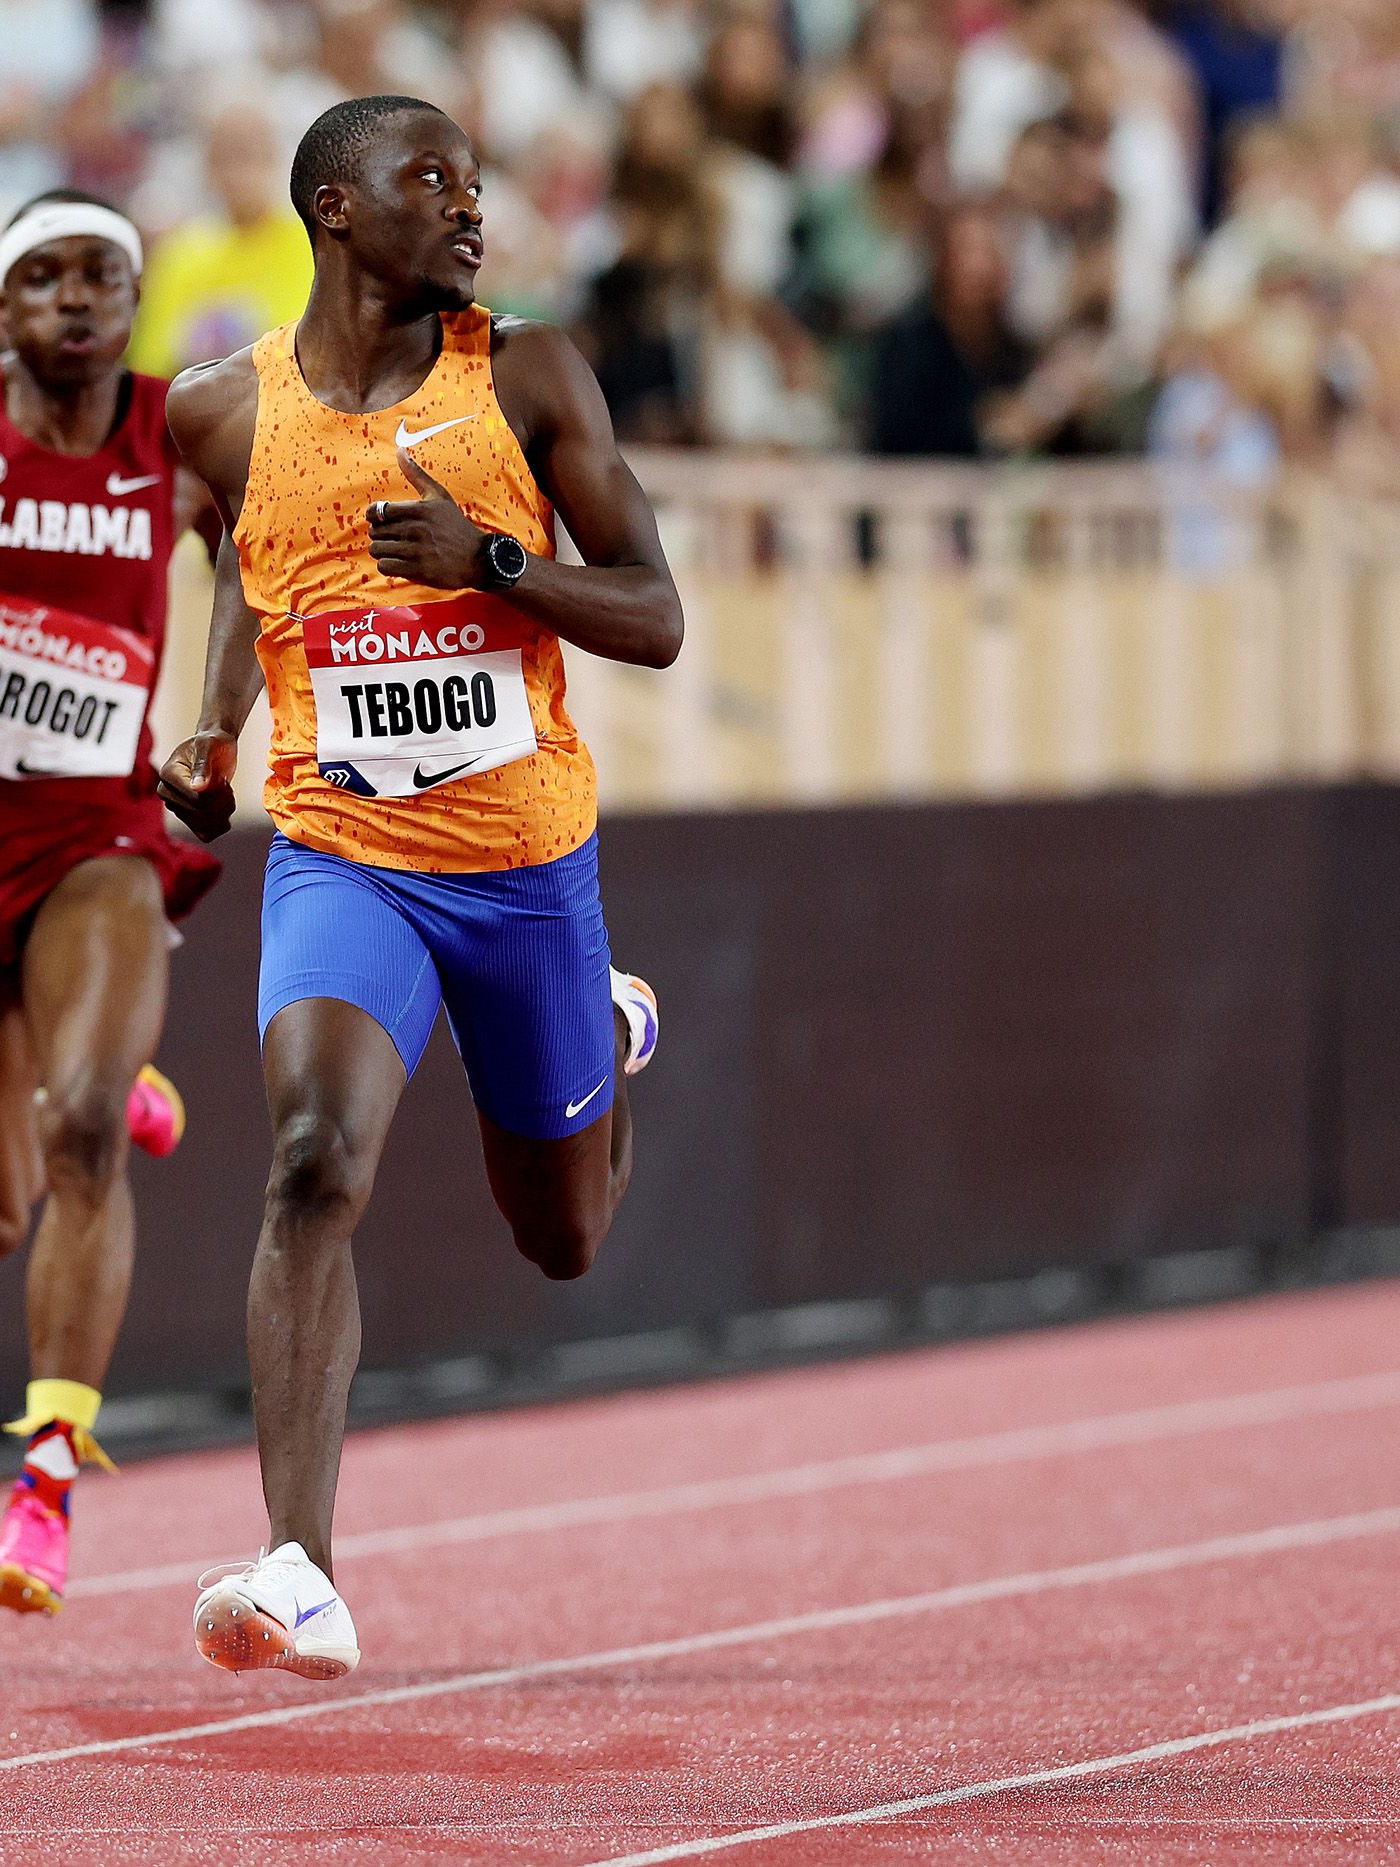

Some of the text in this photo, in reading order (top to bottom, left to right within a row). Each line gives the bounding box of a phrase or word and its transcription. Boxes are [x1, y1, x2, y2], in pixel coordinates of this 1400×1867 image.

[329, 611, 380, 636] visit
[330, 624, 485, 662] MONACO
[340, 671, 497, 739] TEBOGO
